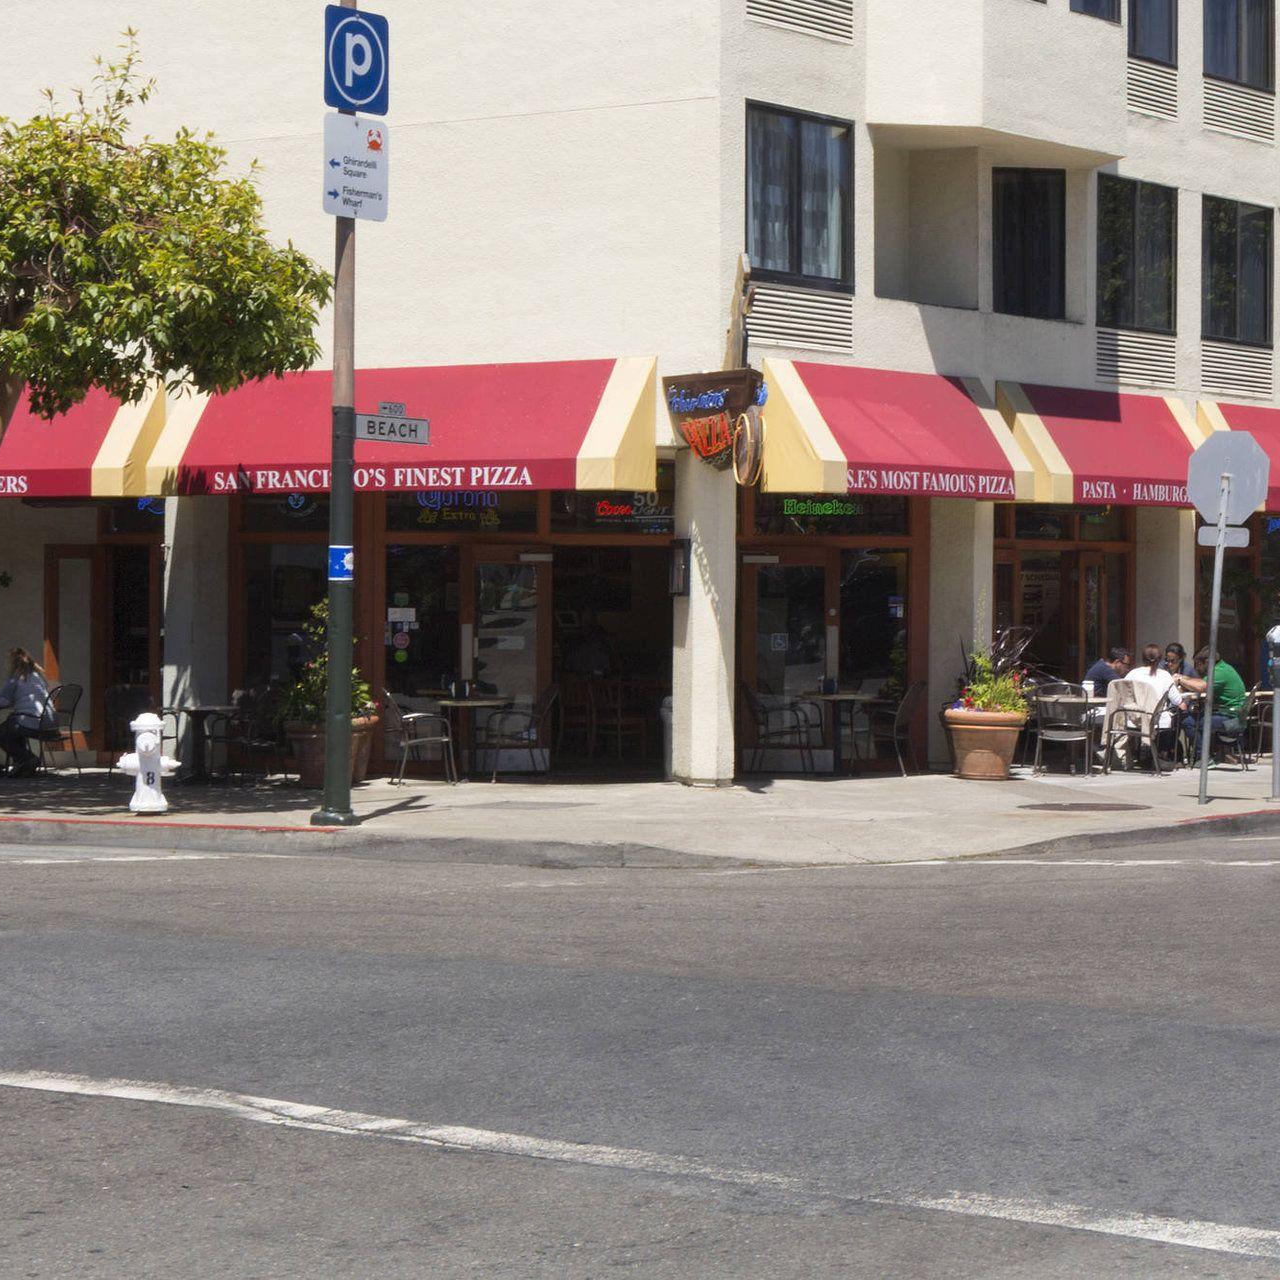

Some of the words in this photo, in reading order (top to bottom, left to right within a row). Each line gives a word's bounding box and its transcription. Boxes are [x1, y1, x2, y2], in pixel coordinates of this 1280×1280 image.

[342, 155, 377, 169] Ghirardelli
[342, 167, 367, 178] Square
[342, 186, 382, 201] Fisherman's
[342, 198, 362, 208] Wharf
[367, 420, 418, 438] BEACH
[680, 413, 732, 460] PIZZA
[214, 471, 252, 490] SAN
[255, 468, 387, 489] FRANCIO'S
[393, 466, 466, 488] FINEST
[469, 466, 533, 486] PIZZA
[880, 470, 920, 491] MOST
[922, 472, 976, 493] FAMOUS
[978, 475, 1016, 495] PIZZA
[1082, 481, 1117, 499] PASTA
[417, 491, 498, 511] Corona
[633, 491, 659, 506] 50
[784, 499, 863, 515] Heineken
[146, 771, 156, 786] 8
